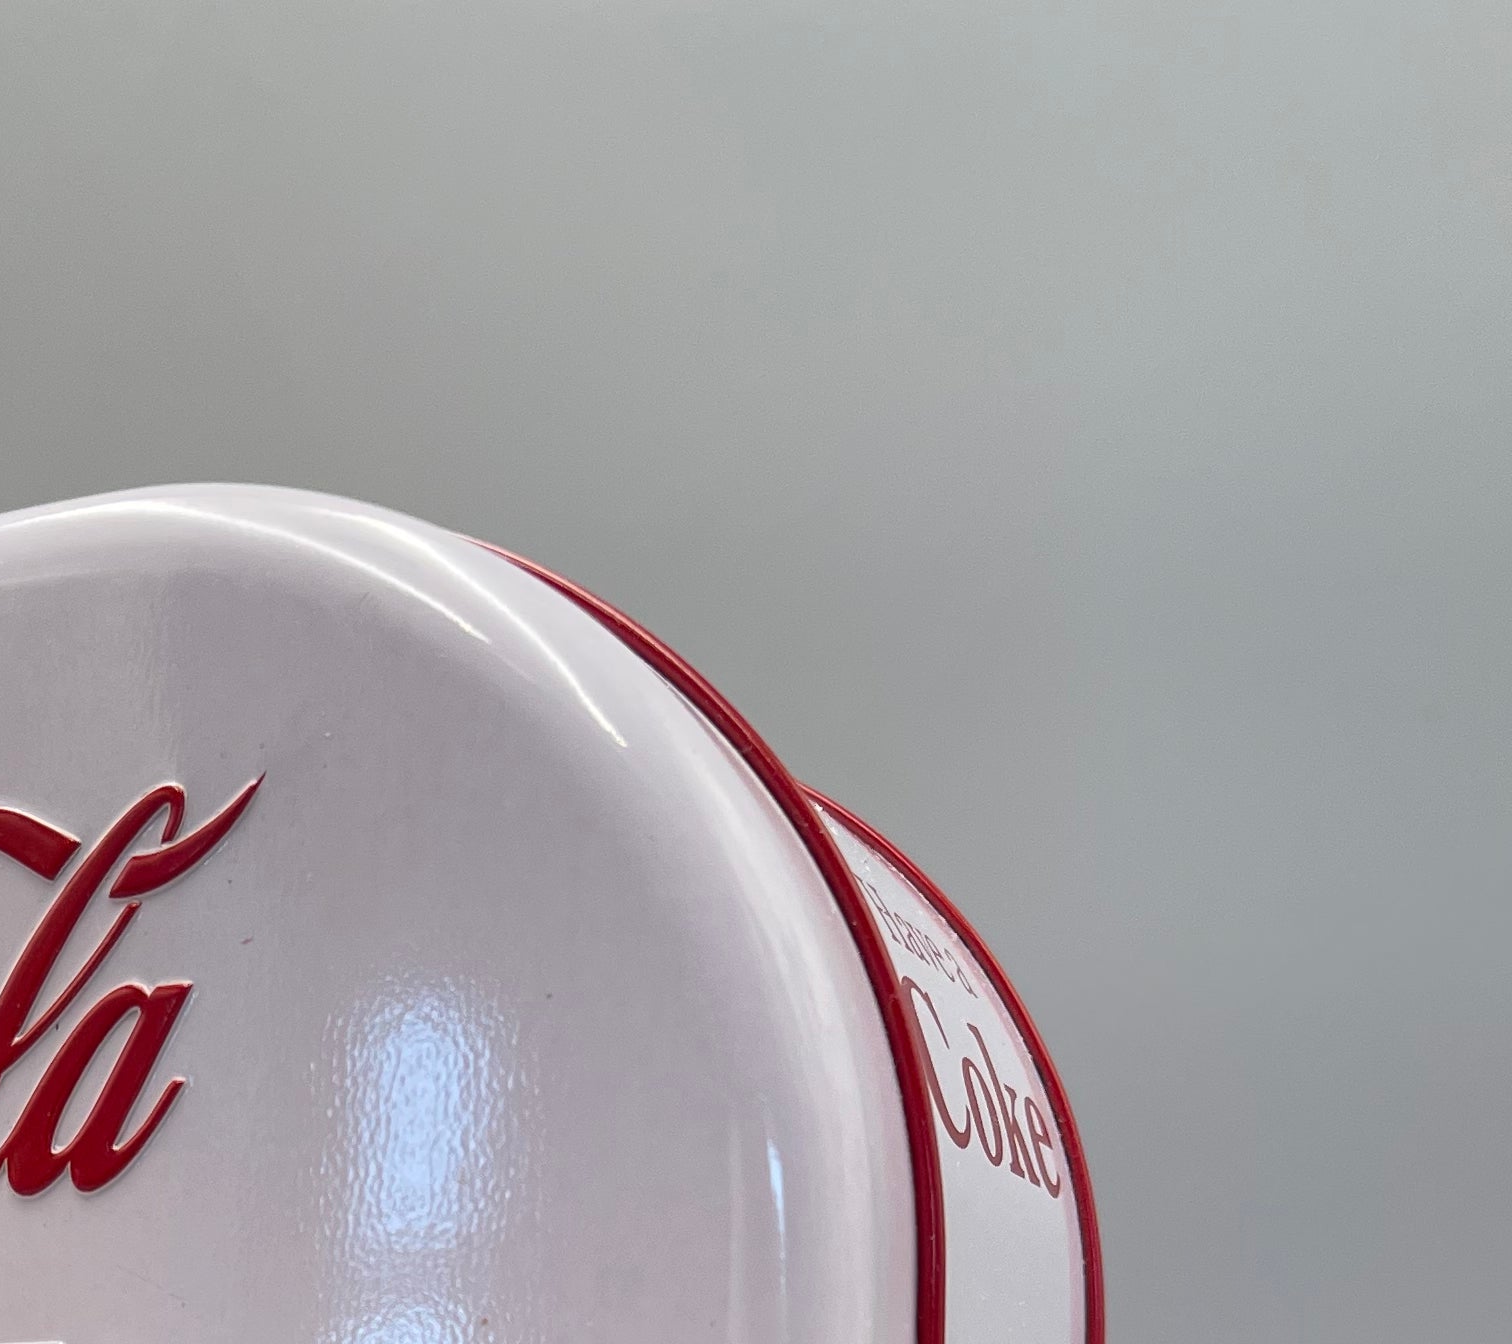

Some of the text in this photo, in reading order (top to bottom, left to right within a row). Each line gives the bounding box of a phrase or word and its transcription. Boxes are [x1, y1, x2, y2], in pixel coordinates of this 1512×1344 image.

[852, 871, 979, 999] Have a
[900, 975, 1062, 1199] Coke
